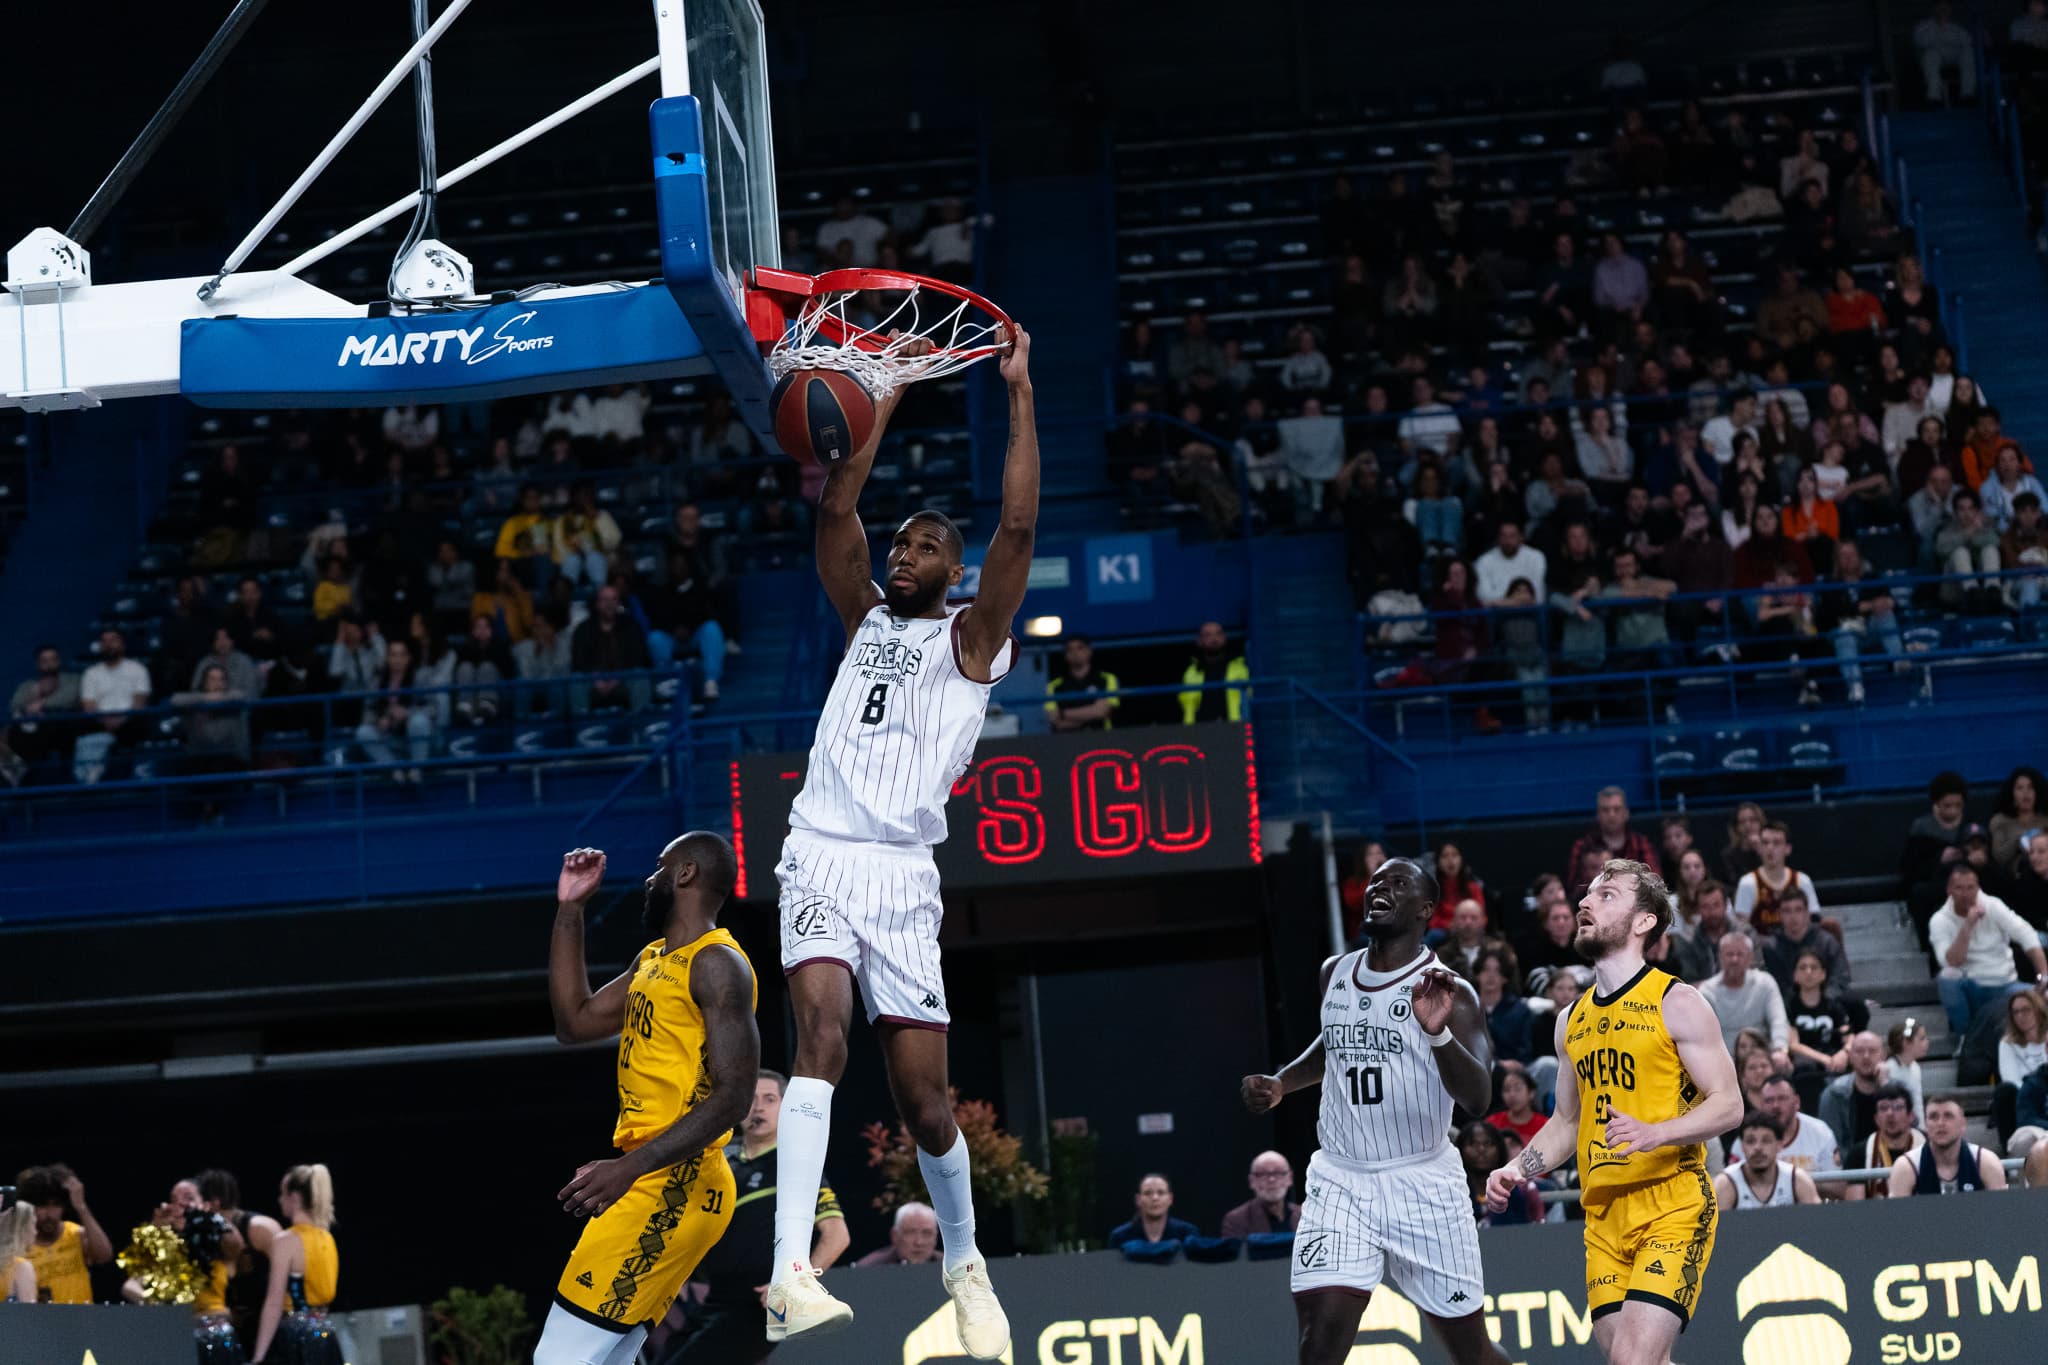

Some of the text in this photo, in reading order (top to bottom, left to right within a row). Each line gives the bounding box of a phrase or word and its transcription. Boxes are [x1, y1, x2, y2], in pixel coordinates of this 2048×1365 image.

[338, 310, 554, 367] MARTY SPORTS
[1098, 553, 1140, 584] K1
[860, 683, 889, 726] 8
[1071, 744, 1211, 858] GO
[1323, 1018, 1403, 1054] ORLÉANS
[1626, 1023, 1656, 1033] IMERYS
[1339, 1052, 1388, 1063] MÉTROPOLE
[1346, 1067, 1383, 1105] 10
[701, 1188, 723, 1214] 31
[1873, 1255, 2042, 1322] GTM
[1038, 1313, 1204, 1365] GTM
[1880, 1332, 1961, 1365] SUD
